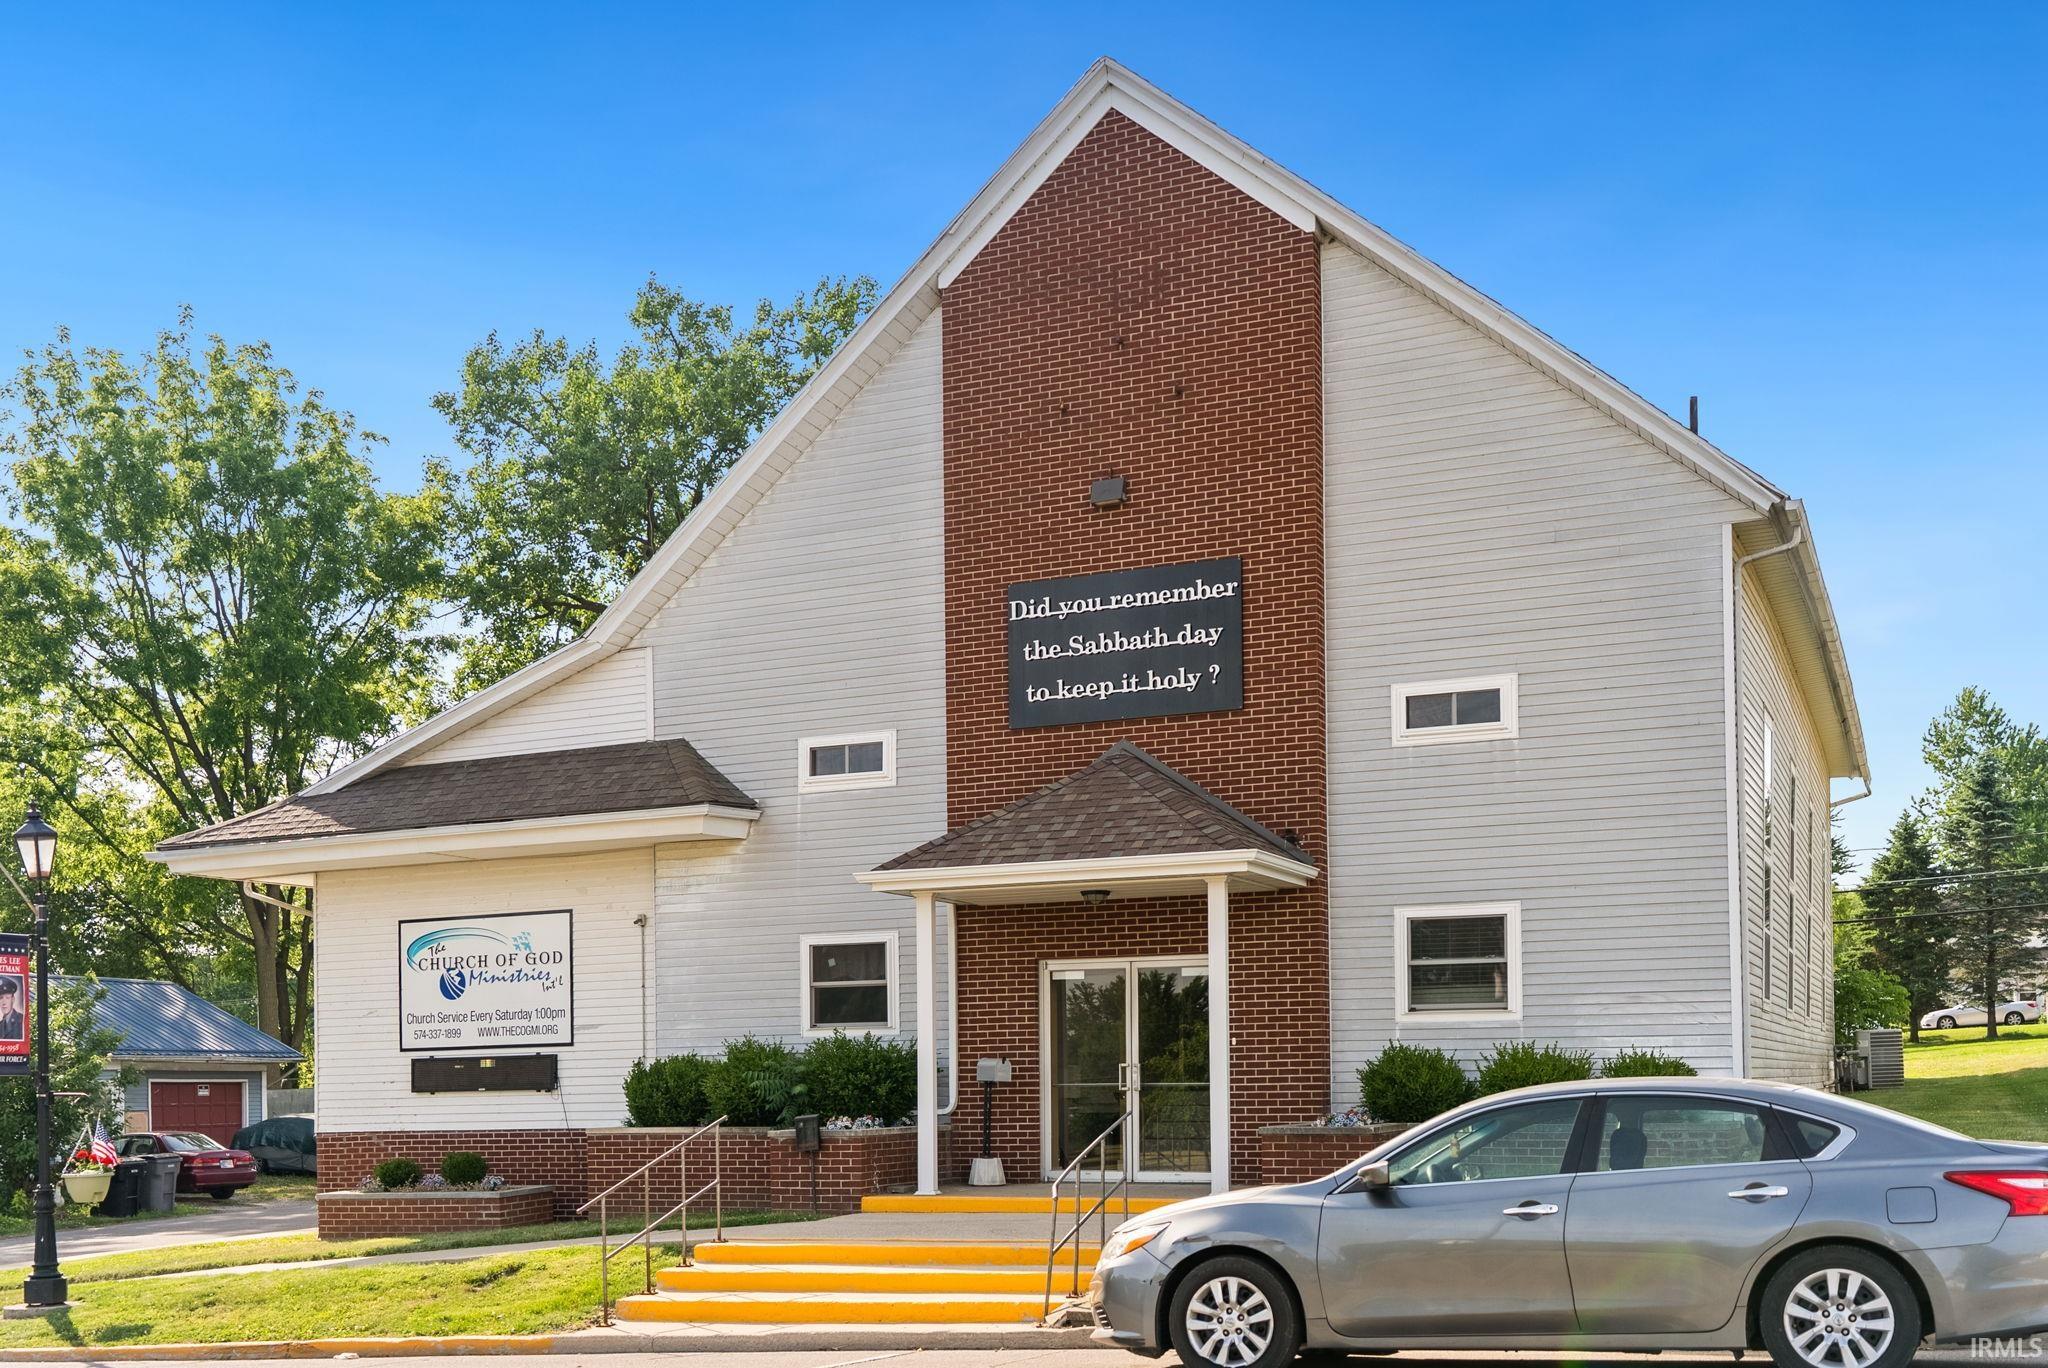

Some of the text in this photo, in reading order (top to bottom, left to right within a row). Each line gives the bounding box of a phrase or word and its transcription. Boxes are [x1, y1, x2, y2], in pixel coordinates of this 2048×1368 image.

[1009, 579, 1238, 621] Did you remember
[1023, 623, 1223, 662] the Sabbath day
[1026, 664, 1220, 703] to keep it holy ?
[427, 942, 447, 957] The
[9, 957, 21, 965] LEE
[418, 951, 563, 971] CHURCH OF GOD
[469, 968, 552, 986] Ministries
[407, 1007, 565, 1025] Church Service Every Saturday 1:00pm
[413, 1024, 559, 1040] 574-337-1899 WWW.THECOGMI.ORG
[6, 1055, 23, 1063] FORCE
